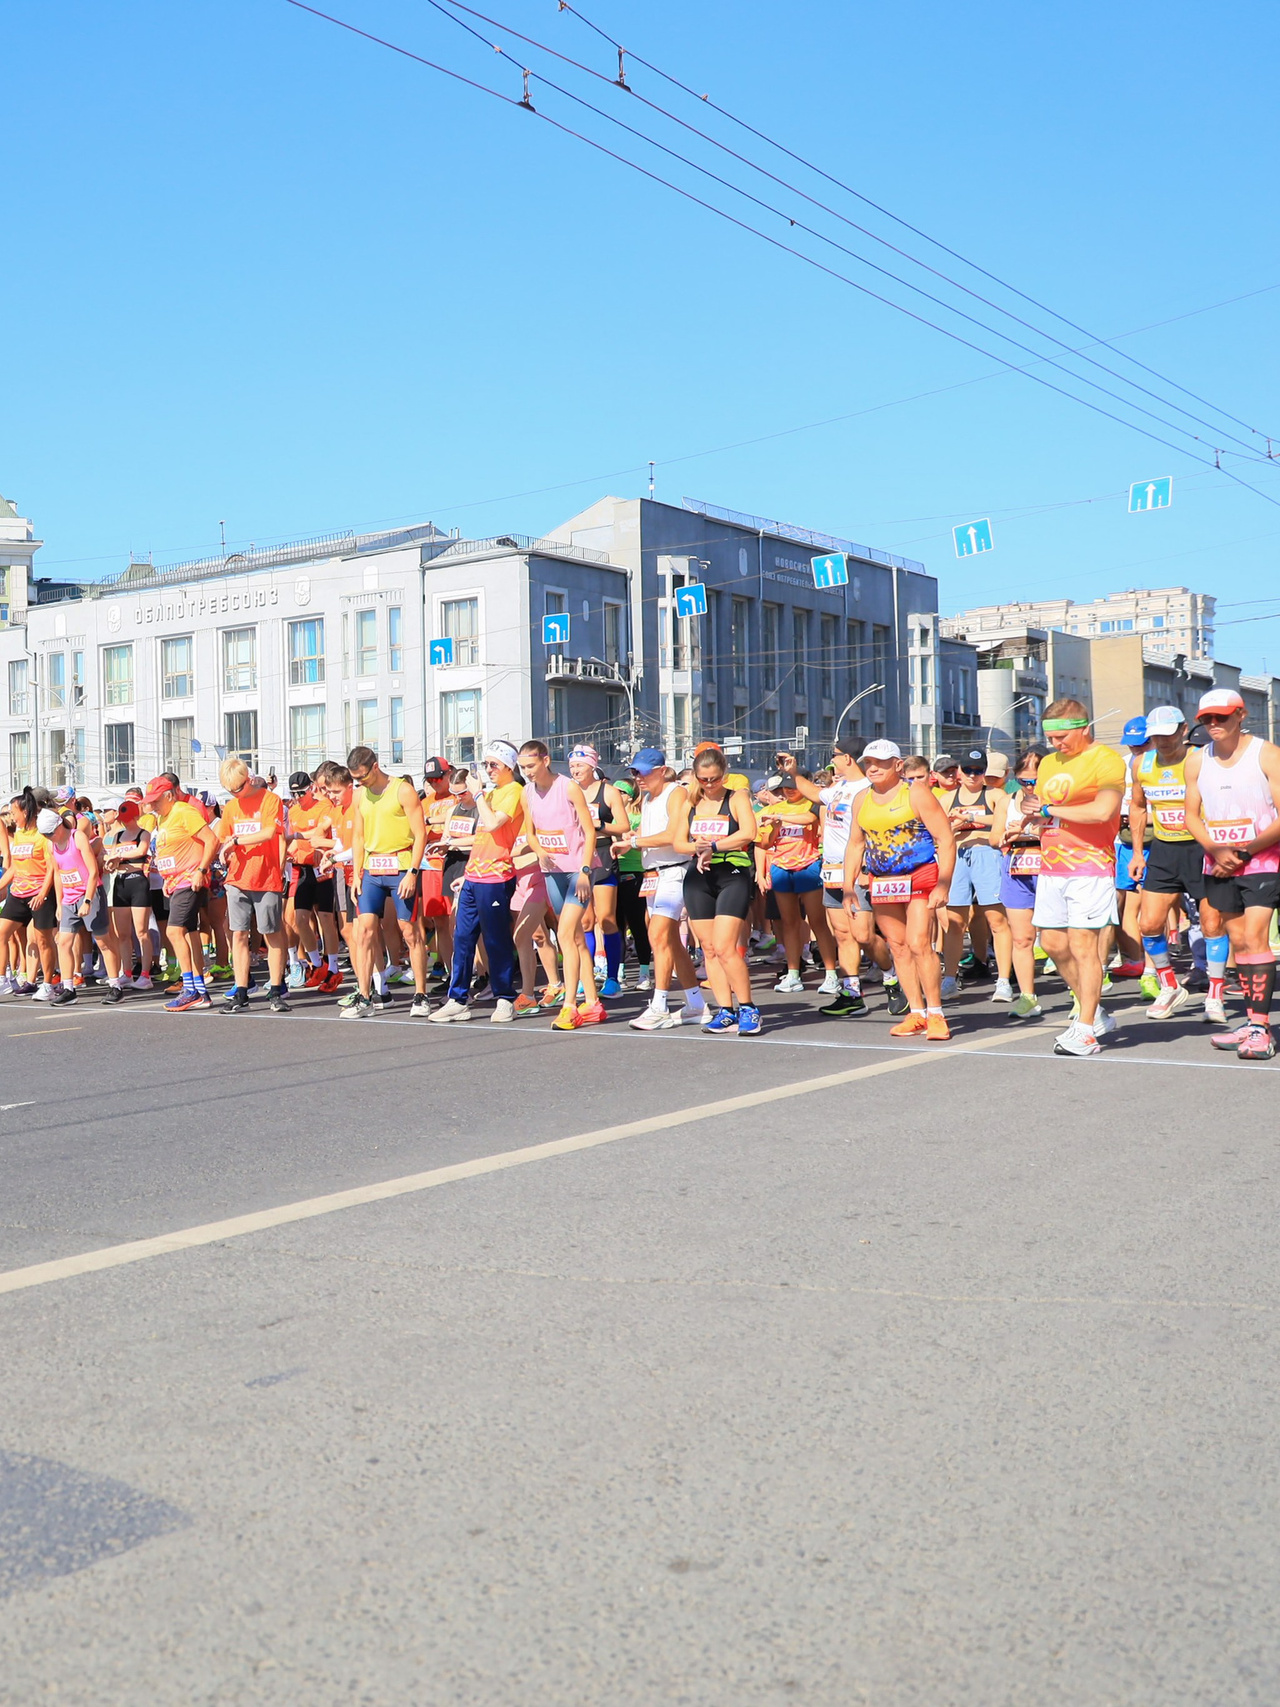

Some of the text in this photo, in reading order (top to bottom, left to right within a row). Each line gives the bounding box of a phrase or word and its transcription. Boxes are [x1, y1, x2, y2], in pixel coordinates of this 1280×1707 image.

[135, 588, 279, 624] ОБЛПОТРЕБСОЮЗ
[236, 824, 256, 833] 1776
[451, 822, 469, 832] 1848
[694, 822, 724, 833] 1847
[1213, 828, 1248, 841] 1967
[540, 836, 563, 846] 2001
[14, 844, 30, 853] 1434
[372, 858, 393, 867] 1521
[1012, 856, 1041, 867] 2208
[876, 883, 906, 894] 1432
